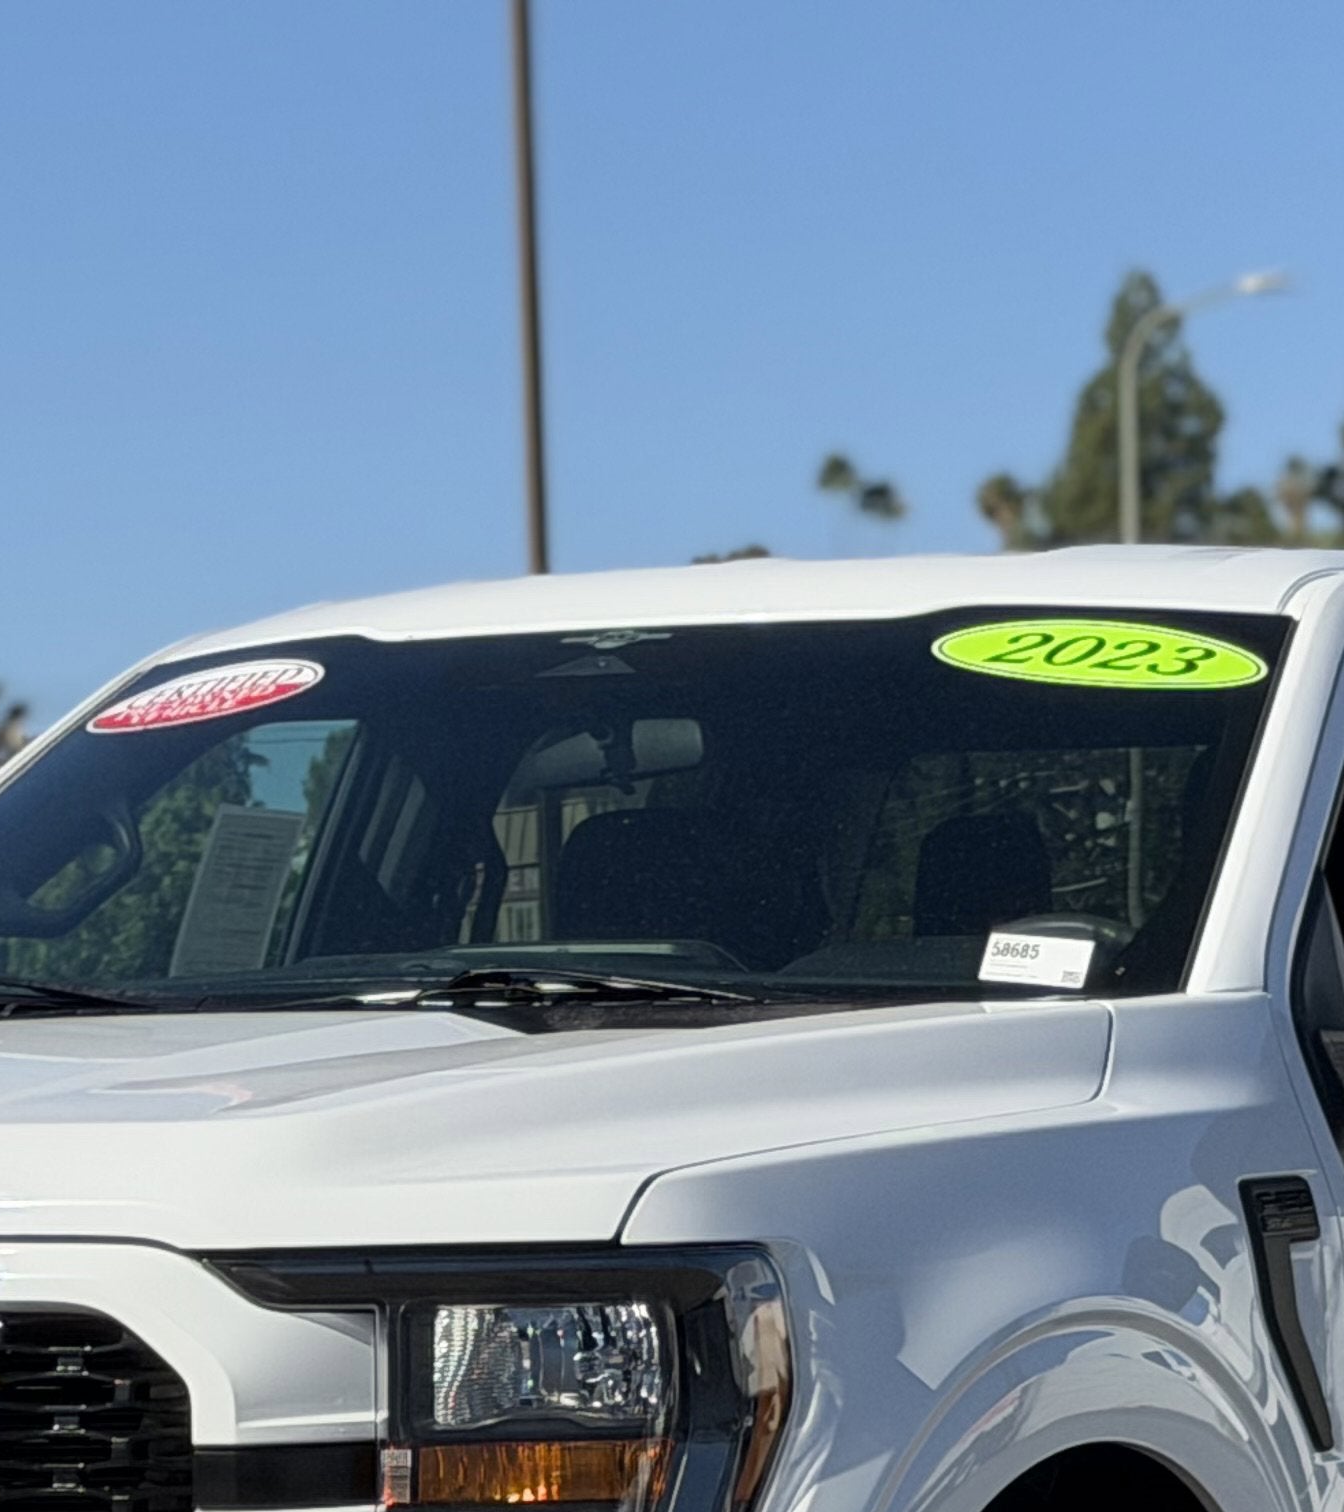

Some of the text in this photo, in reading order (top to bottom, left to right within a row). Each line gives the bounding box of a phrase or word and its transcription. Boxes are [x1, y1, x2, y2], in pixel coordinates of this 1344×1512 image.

[983, 632, 1217, 676] 2023
[127, 667, 304, 710] CERTIFIED
[991, 941, 1041, 960] 58685
